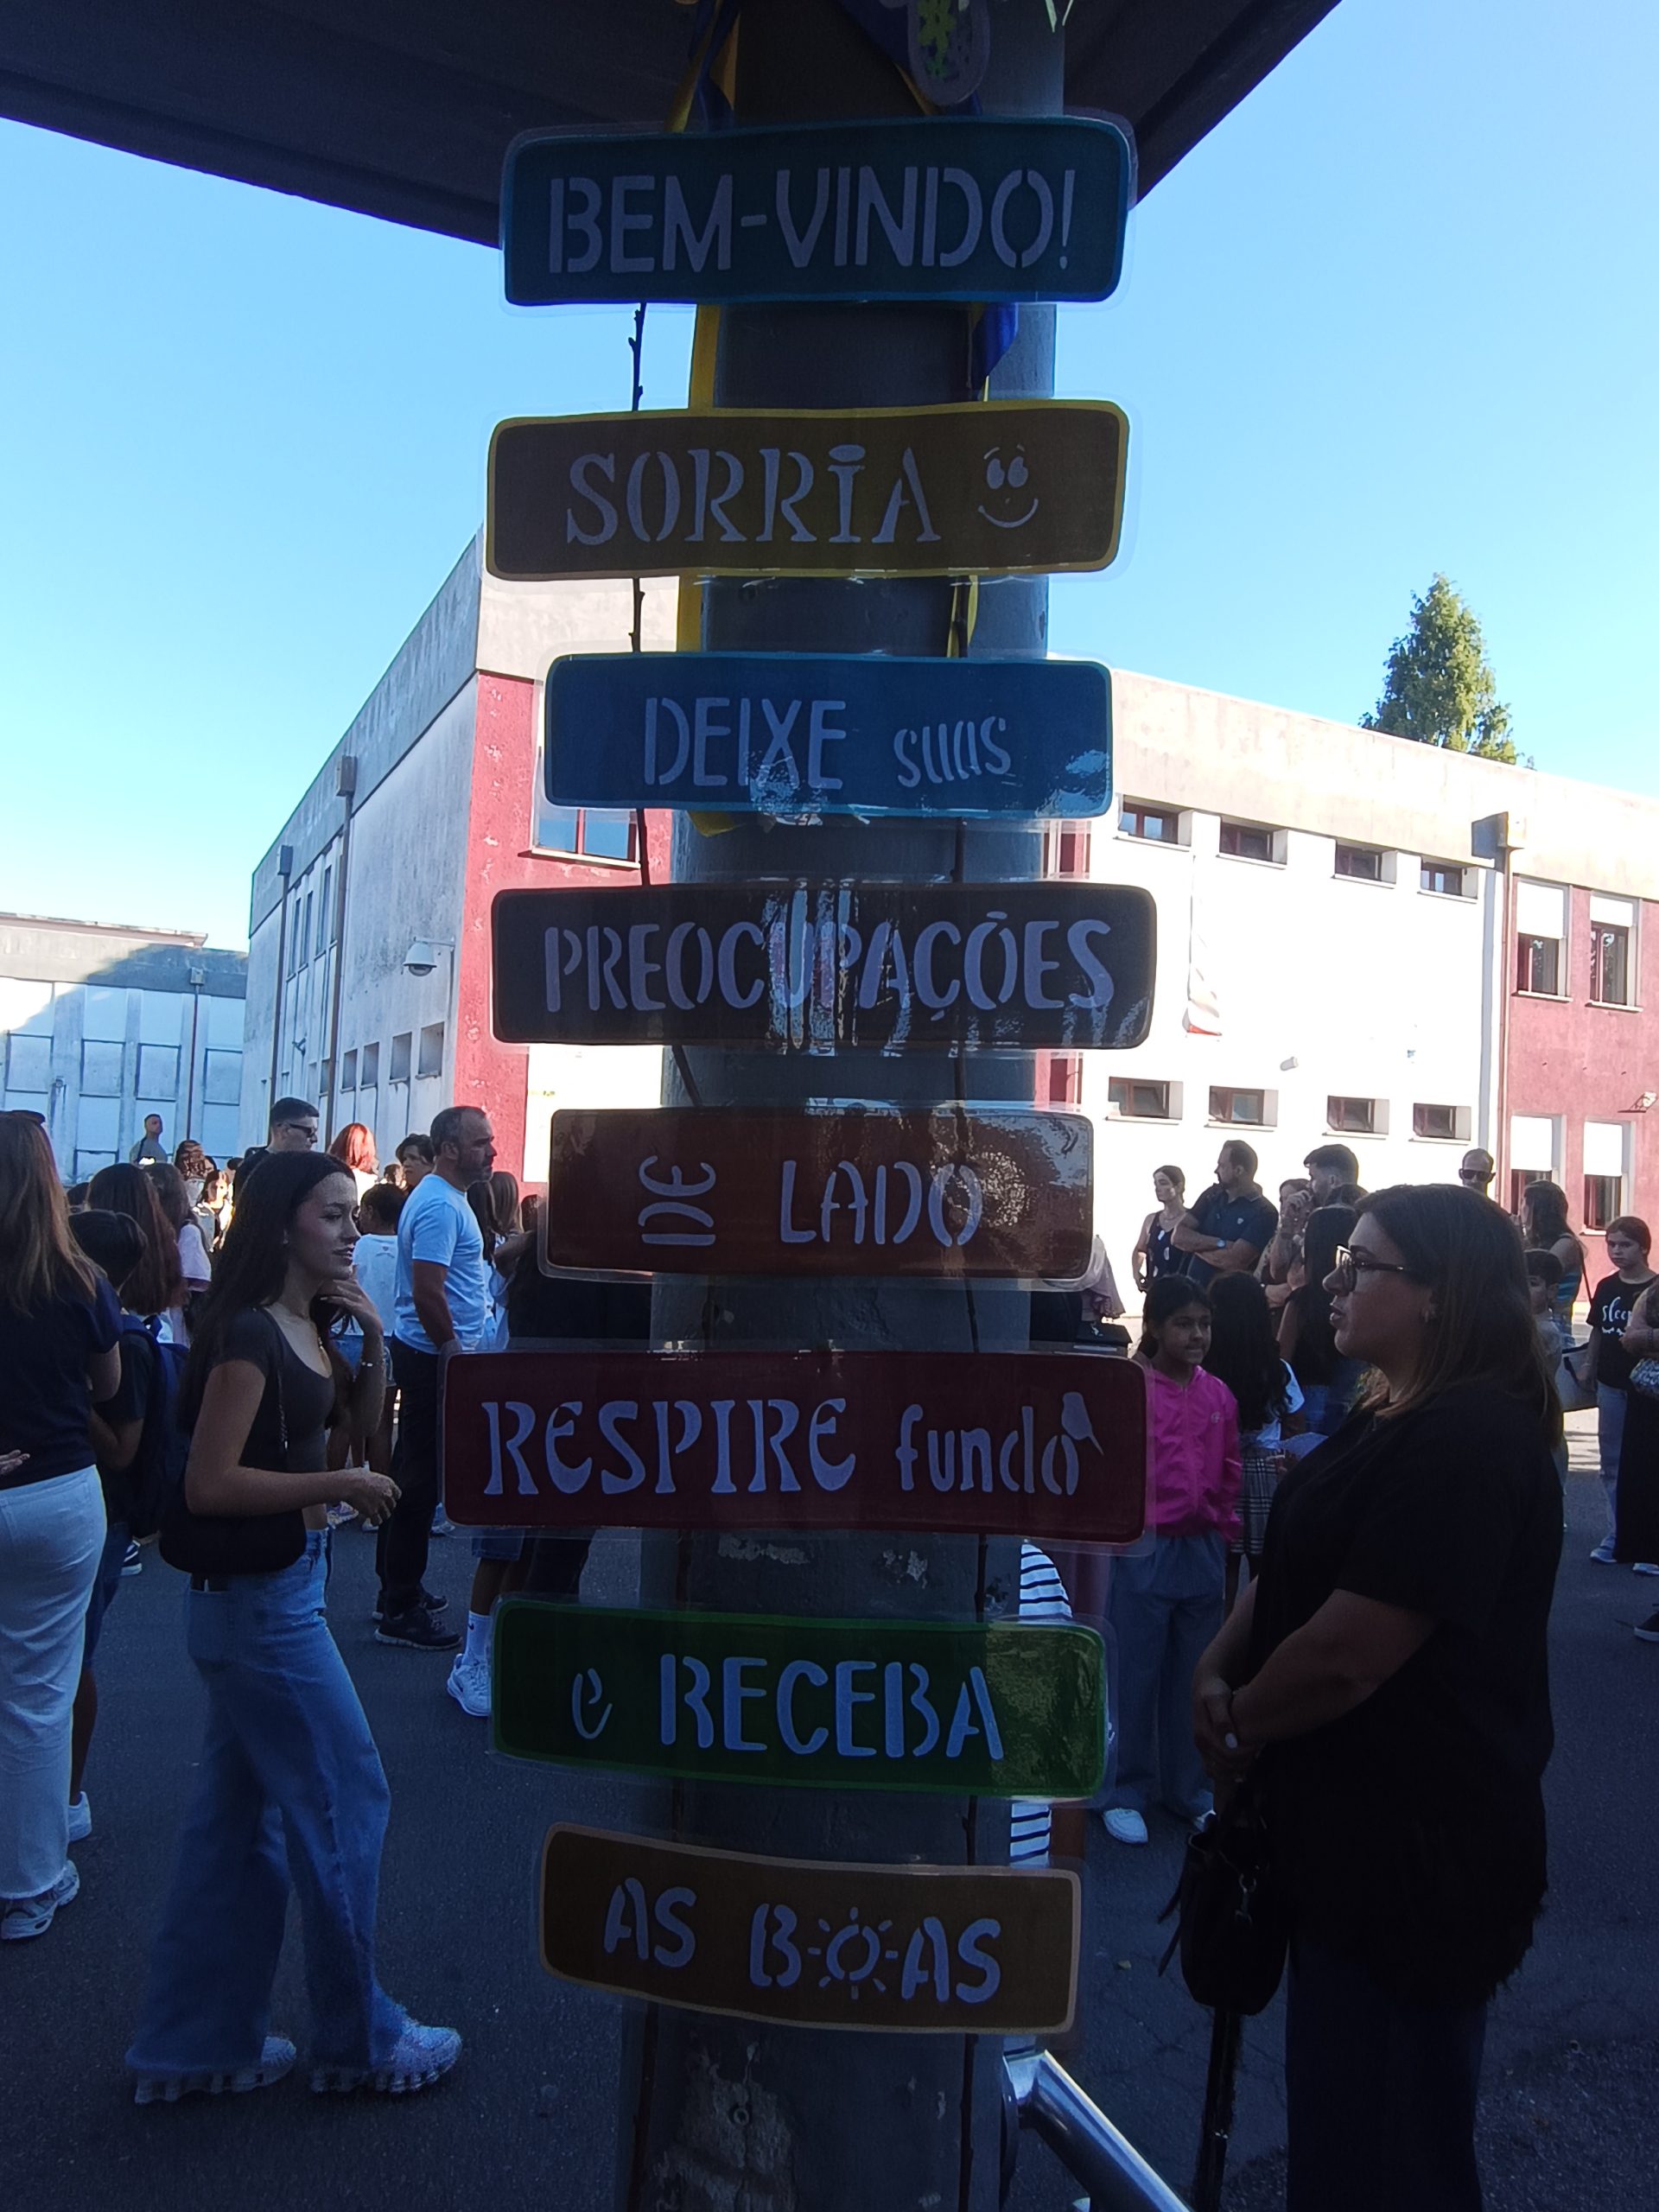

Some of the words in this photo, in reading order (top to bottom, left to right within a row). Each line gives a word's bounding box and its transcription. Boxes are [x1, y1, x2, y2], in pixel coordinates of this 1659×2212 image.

[548, 167, 1077, 274] BEM-VINDO!
[644, 696, 847, 791] DEIXE
[779, 1159, 984, 1249] LADO
[659, 1654, 1004, 1760] RECEBA
[603, 1877, 698, 1969] AS
